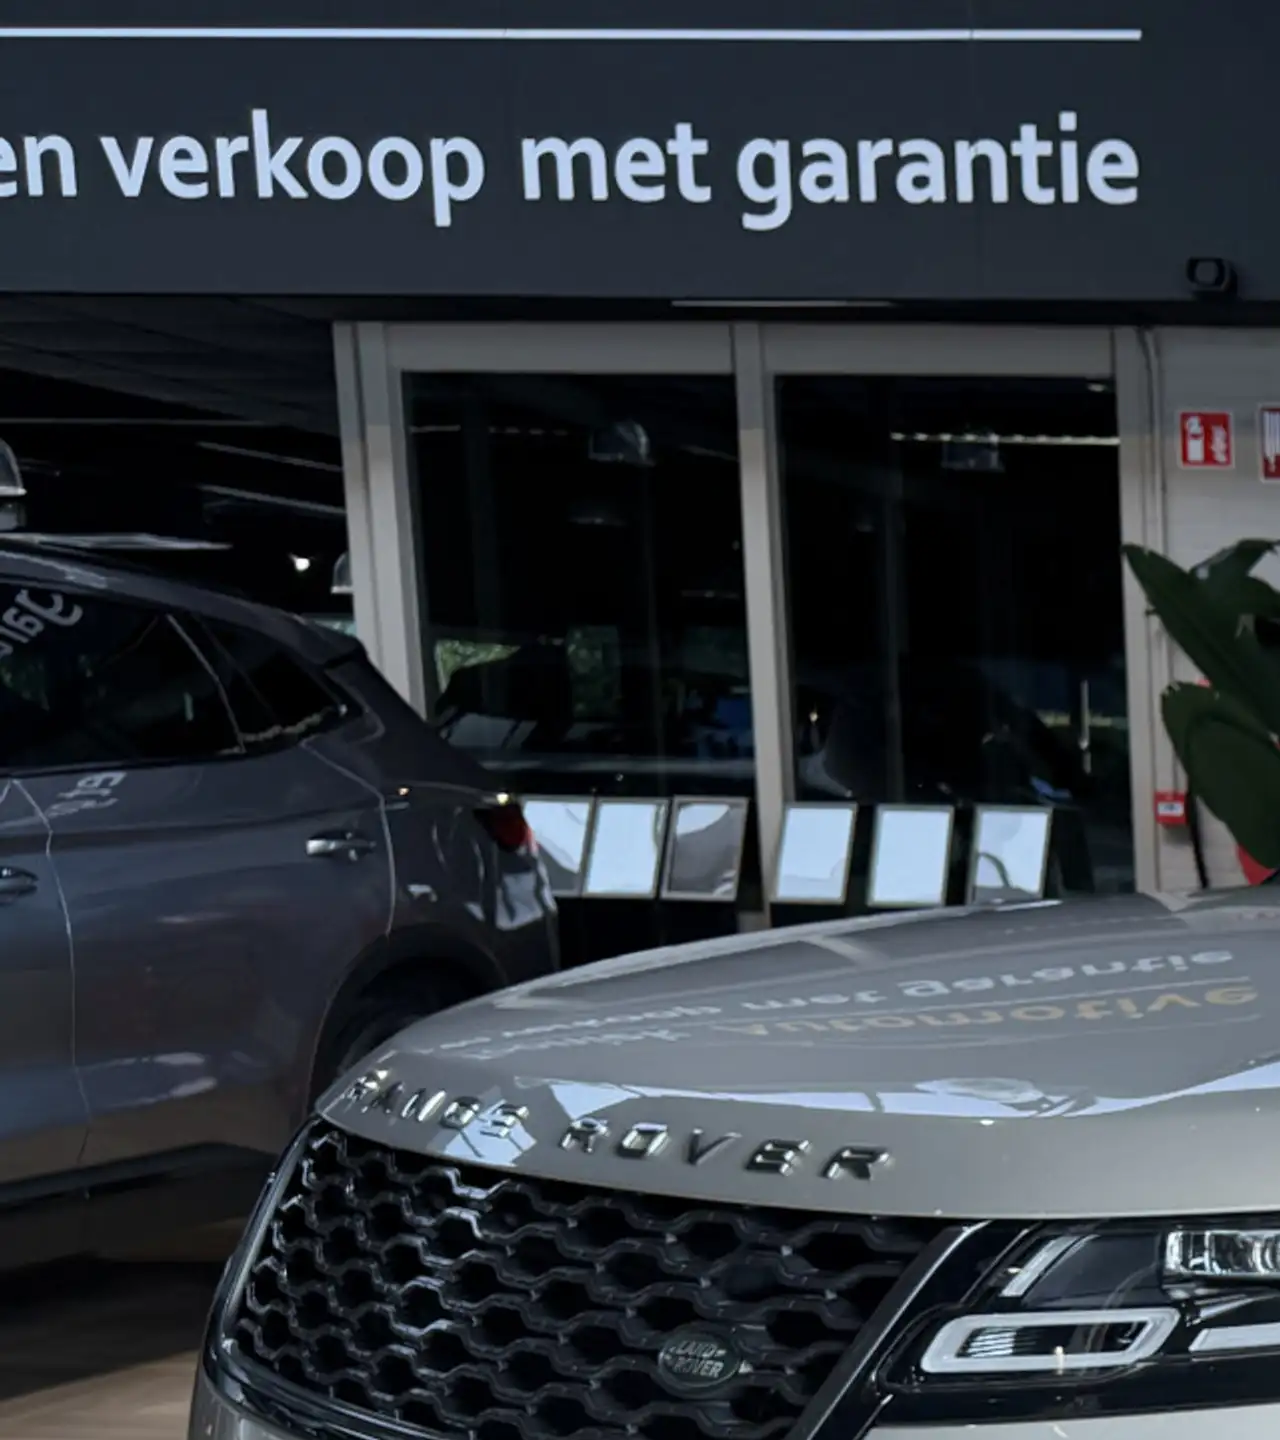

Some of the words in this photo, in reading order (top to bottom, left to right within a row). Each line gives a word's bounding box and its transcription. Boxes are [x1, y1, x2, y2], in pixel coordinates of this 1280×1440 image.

[99, 108, 485, 227] verkoop
[521, 122, 711, 203] met
[736, 111, 1139, 231] garantie
[558, 1114, 897, 1182] ROVER
